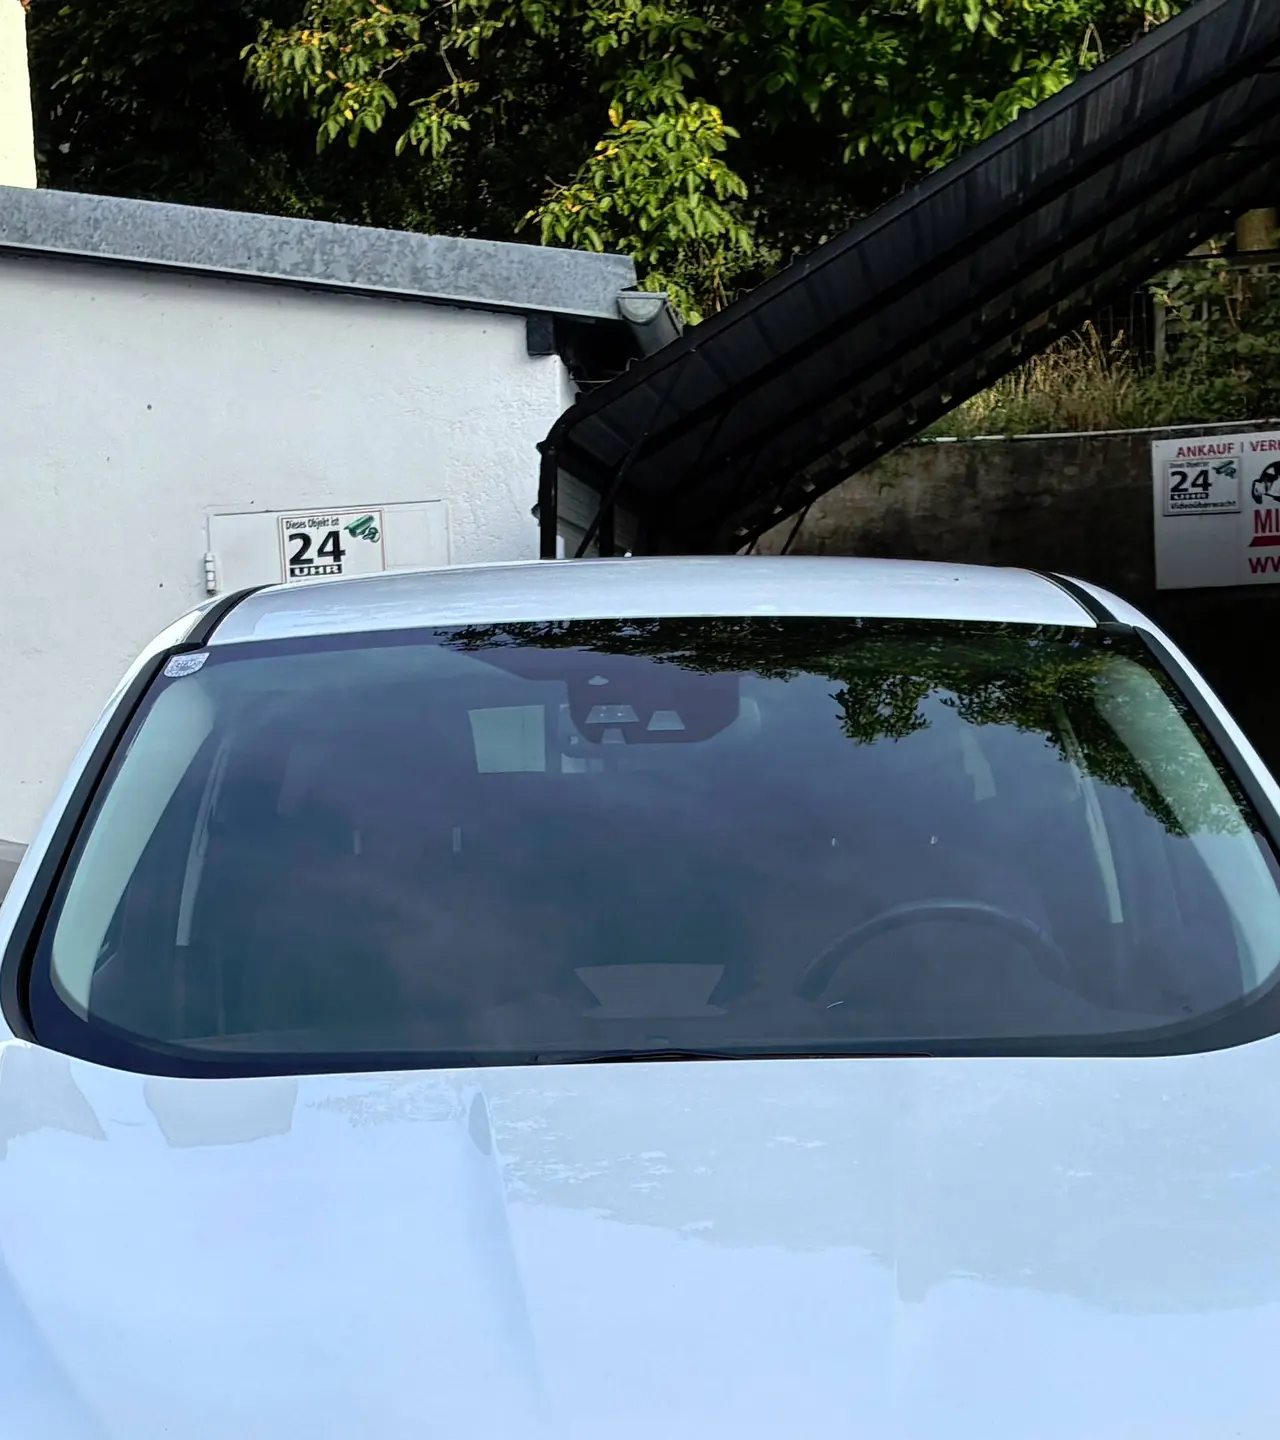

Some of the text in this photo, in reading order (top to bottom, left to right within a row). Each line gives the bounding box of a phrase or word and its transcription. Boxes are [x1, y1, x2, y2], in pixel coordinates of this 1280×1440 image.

[1176, 442, 1235, 459] ANKAUF
[1170, 470, 1212, 492] 24
[286, 517, 339, 530] Dieses Objekt ist
[288, 530, 346, 566] 24
[294, 565, 340, 576] UHR
